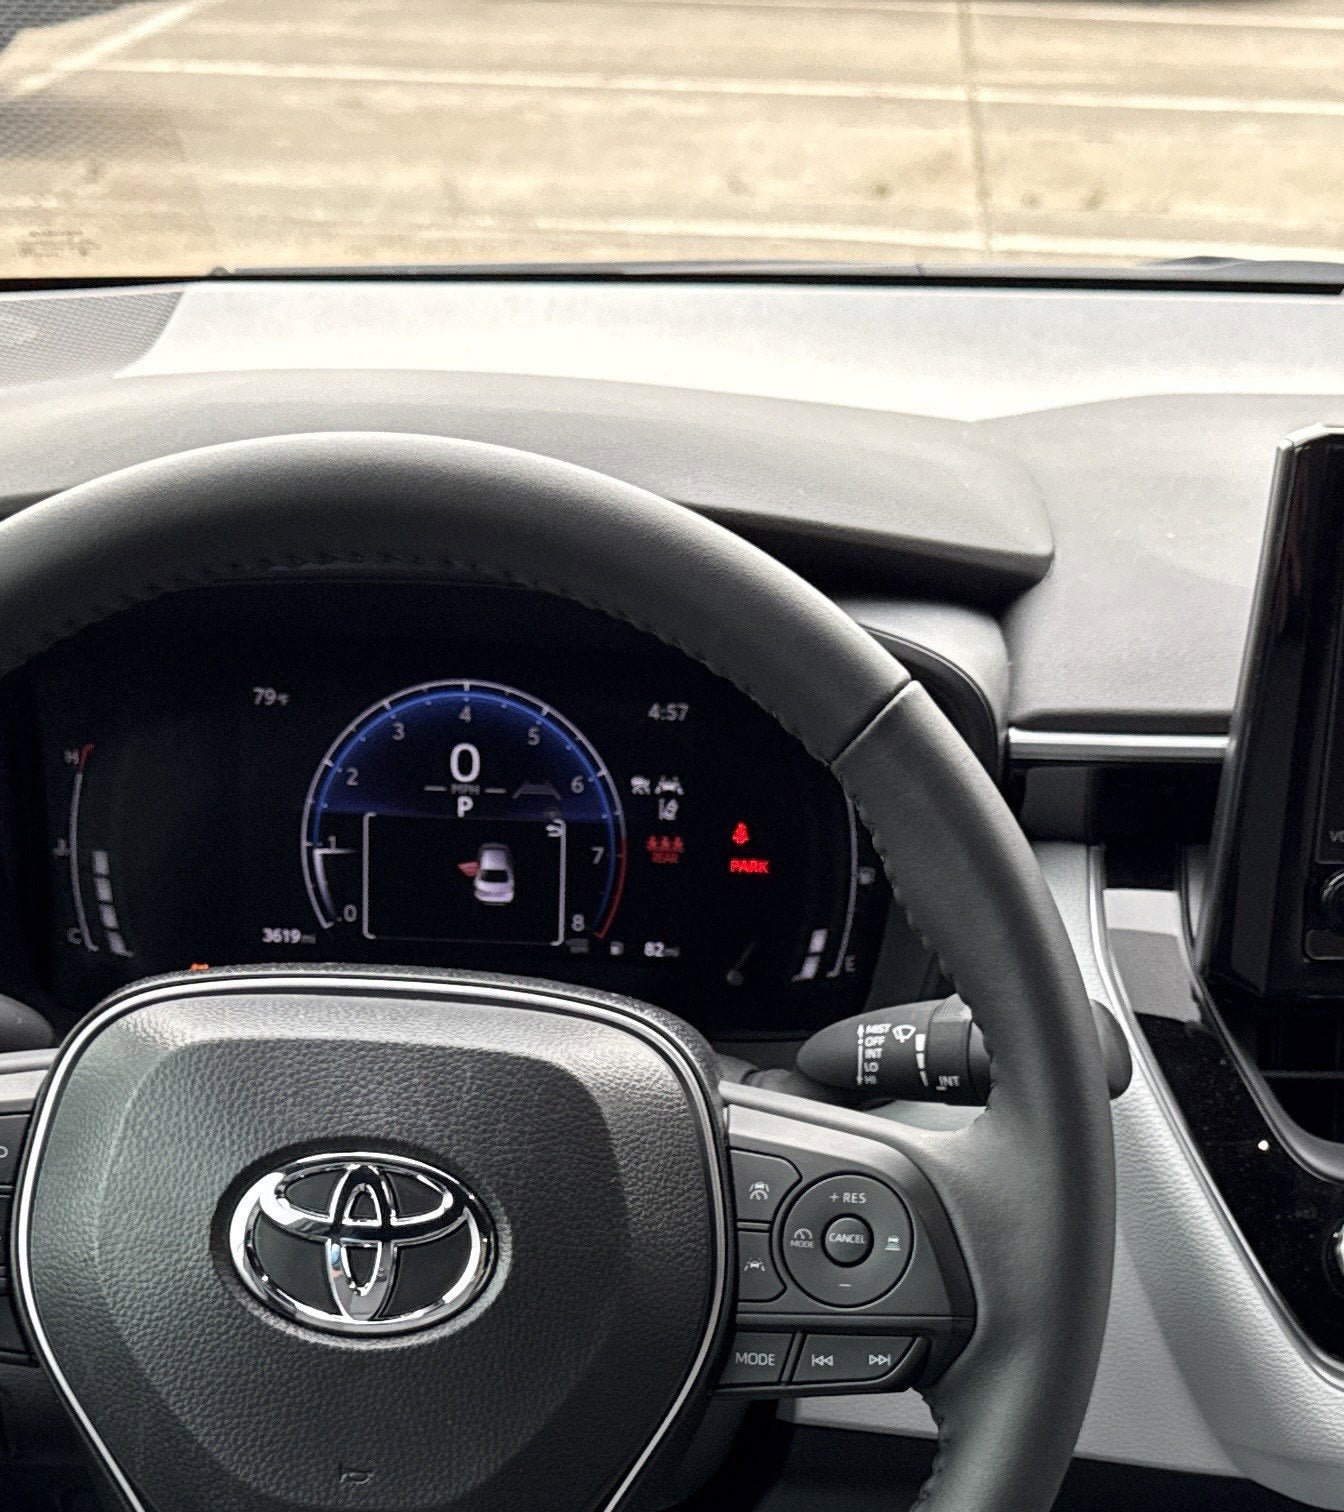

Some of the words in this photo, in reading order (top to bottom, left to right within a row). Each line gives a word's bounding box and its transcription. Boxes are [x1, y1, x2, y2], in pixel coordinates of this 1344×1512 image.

[459, 705, 472, 724] 4
[648, 702, 689, 721] 4:57
[392, 722, 405, 741] 3
[527, 726, 541, 746] 5
[449, 743, 481, 783] 0
[346, 767, 359, 786] 2
[570, 775, 585, 794] 6
[457, 795, 474, 818] P
[590, 846, 604, 865] 7
[728, 859, 770, 874] PARK
[343, 904, 357, 923] 0
[571, 914, 585, 932] 8
[261, 927, 301, 944] 3619
[644, 942, 664, 957] 82
[864, 1036, 886, 1047] OFF
[828, 1232, 865, 1244] CANCEL
[735, 1352, 776, 1366] MODE
